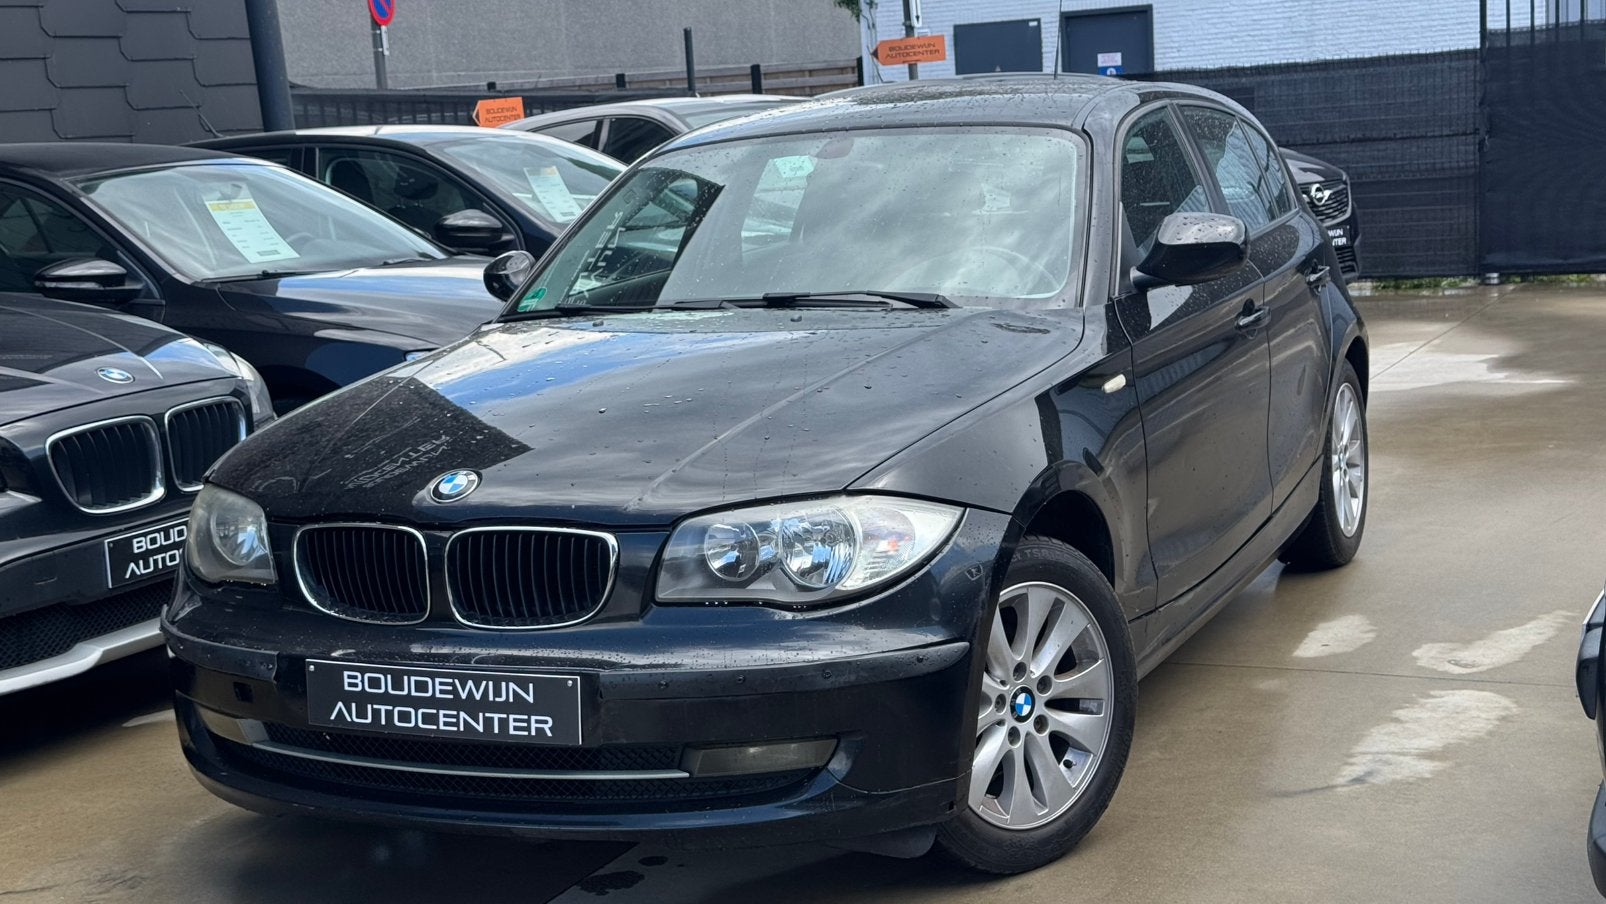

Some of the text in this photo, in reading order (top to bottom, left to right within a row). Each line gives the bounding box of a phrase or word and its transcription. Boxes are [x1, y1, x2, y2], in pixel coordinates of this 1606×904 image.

[885, 49, 940, 59] AUTOCENTER
[888, 42, 936, 52] BOUDEWIJN
[1327, 228, 1343, 237] WIJN
[133, 525, 187, 553] BOUD
[125, 548, 183, 579] AUTO
[343, 670, 533, 703] BOUDEWIJN
[330, 701, 553, 737] AUTOCENTER
